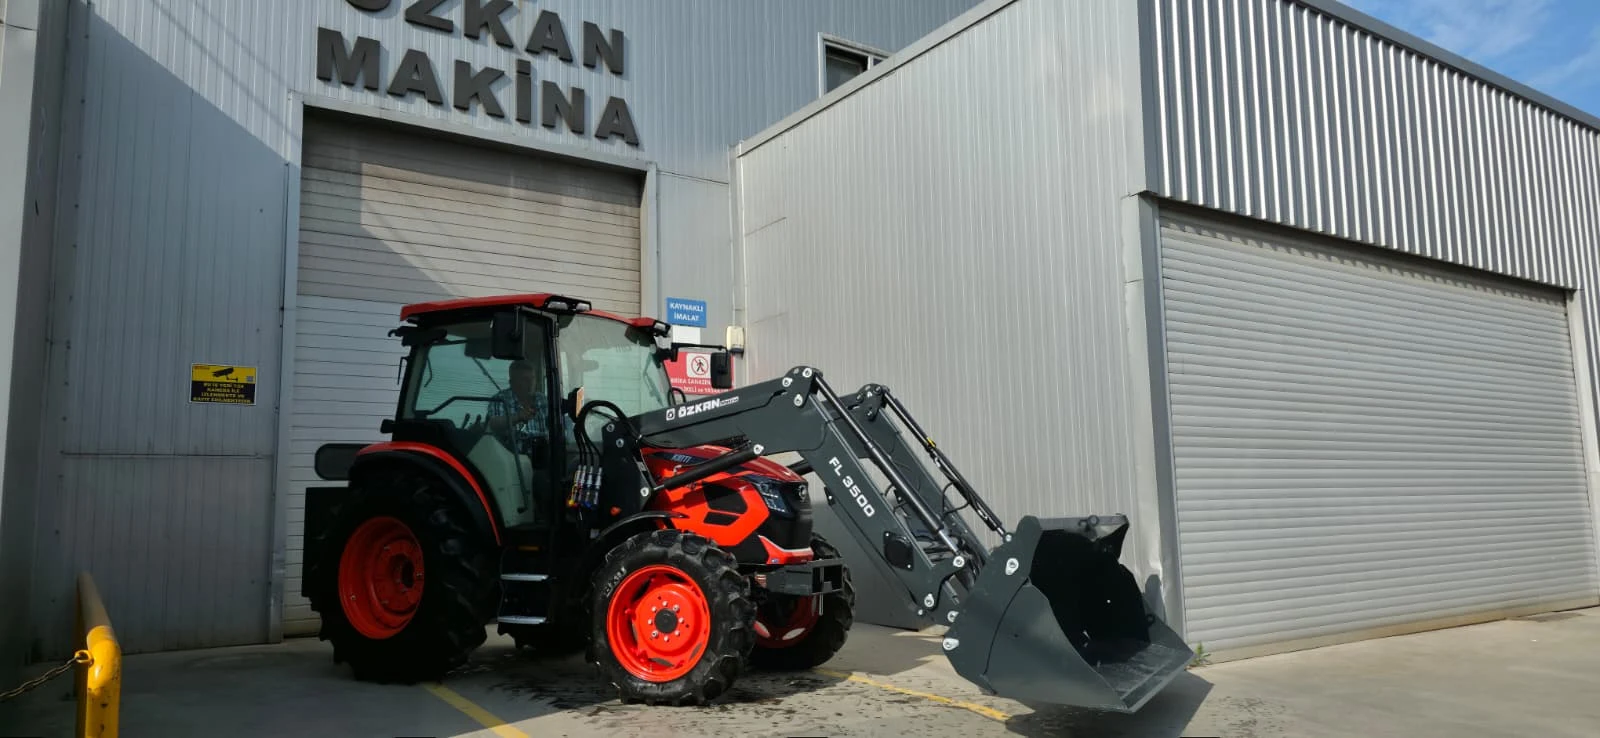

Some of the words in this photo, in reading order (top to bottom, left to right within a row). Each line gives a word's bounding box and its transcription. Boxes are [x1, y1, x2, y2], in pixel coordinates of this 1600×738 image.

[344, 0, 625, 75] ZKAN
[316, 26, 640, 146] MAKİNA
[669, 302, 704, 312] KAYNAKLI
[673, 311, 700, 321] İMALAT
[677, 398, 720, 418] ÖZKAN
[828, 456, 843, 476] FL
[842, 475, 876, 517] 3500
